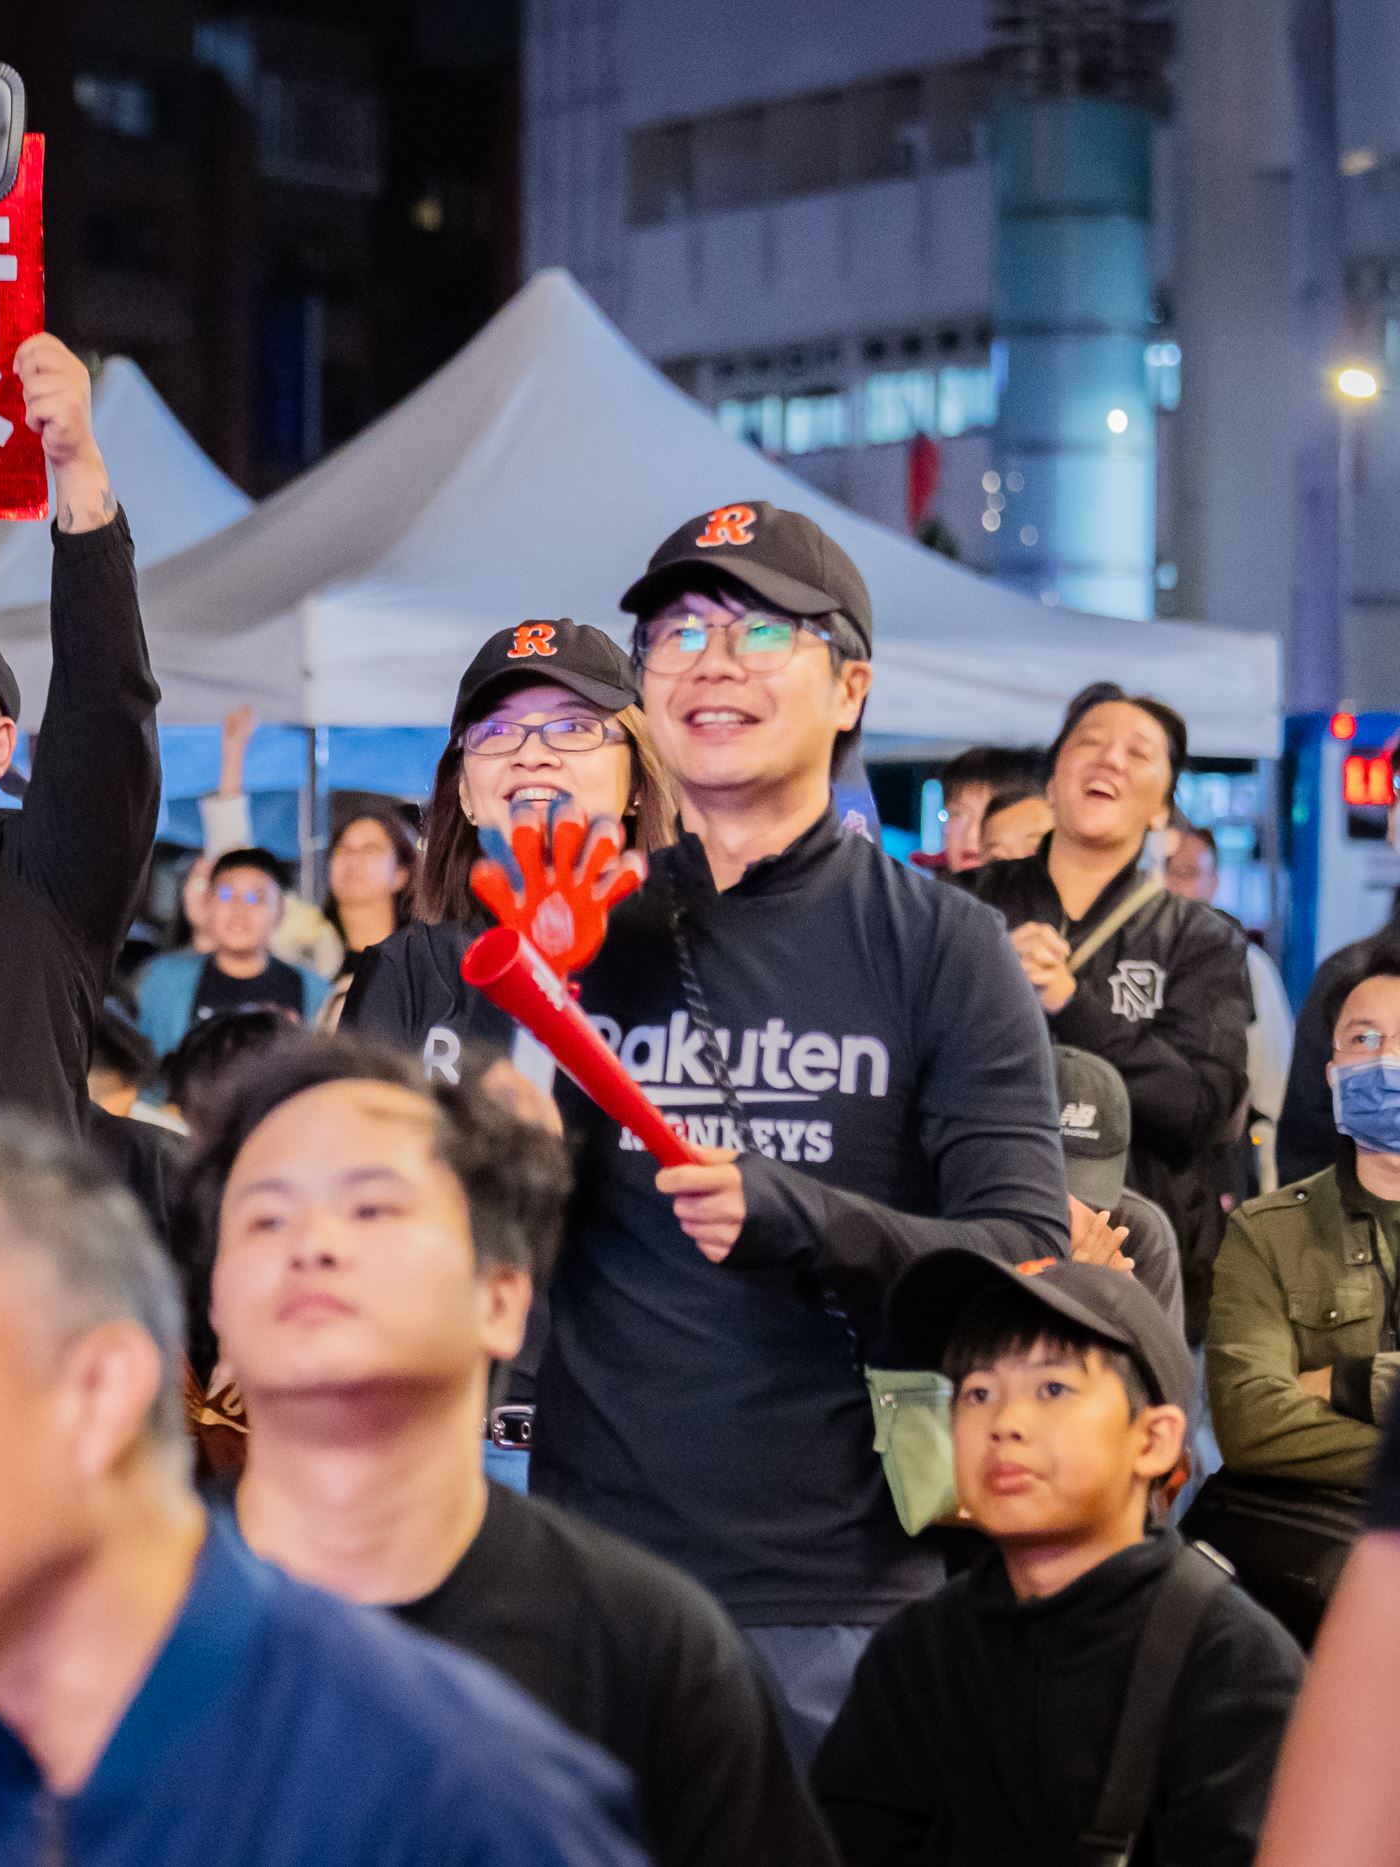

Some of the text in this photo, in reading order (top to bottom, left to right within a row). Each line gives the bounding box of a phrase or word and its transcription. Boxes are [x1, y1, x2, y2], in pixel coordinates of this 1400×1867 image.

[695, 504, 757, 548] R
[507, 622, 558, 659] R
[619, 1112, 833, 1163] NKEYS
